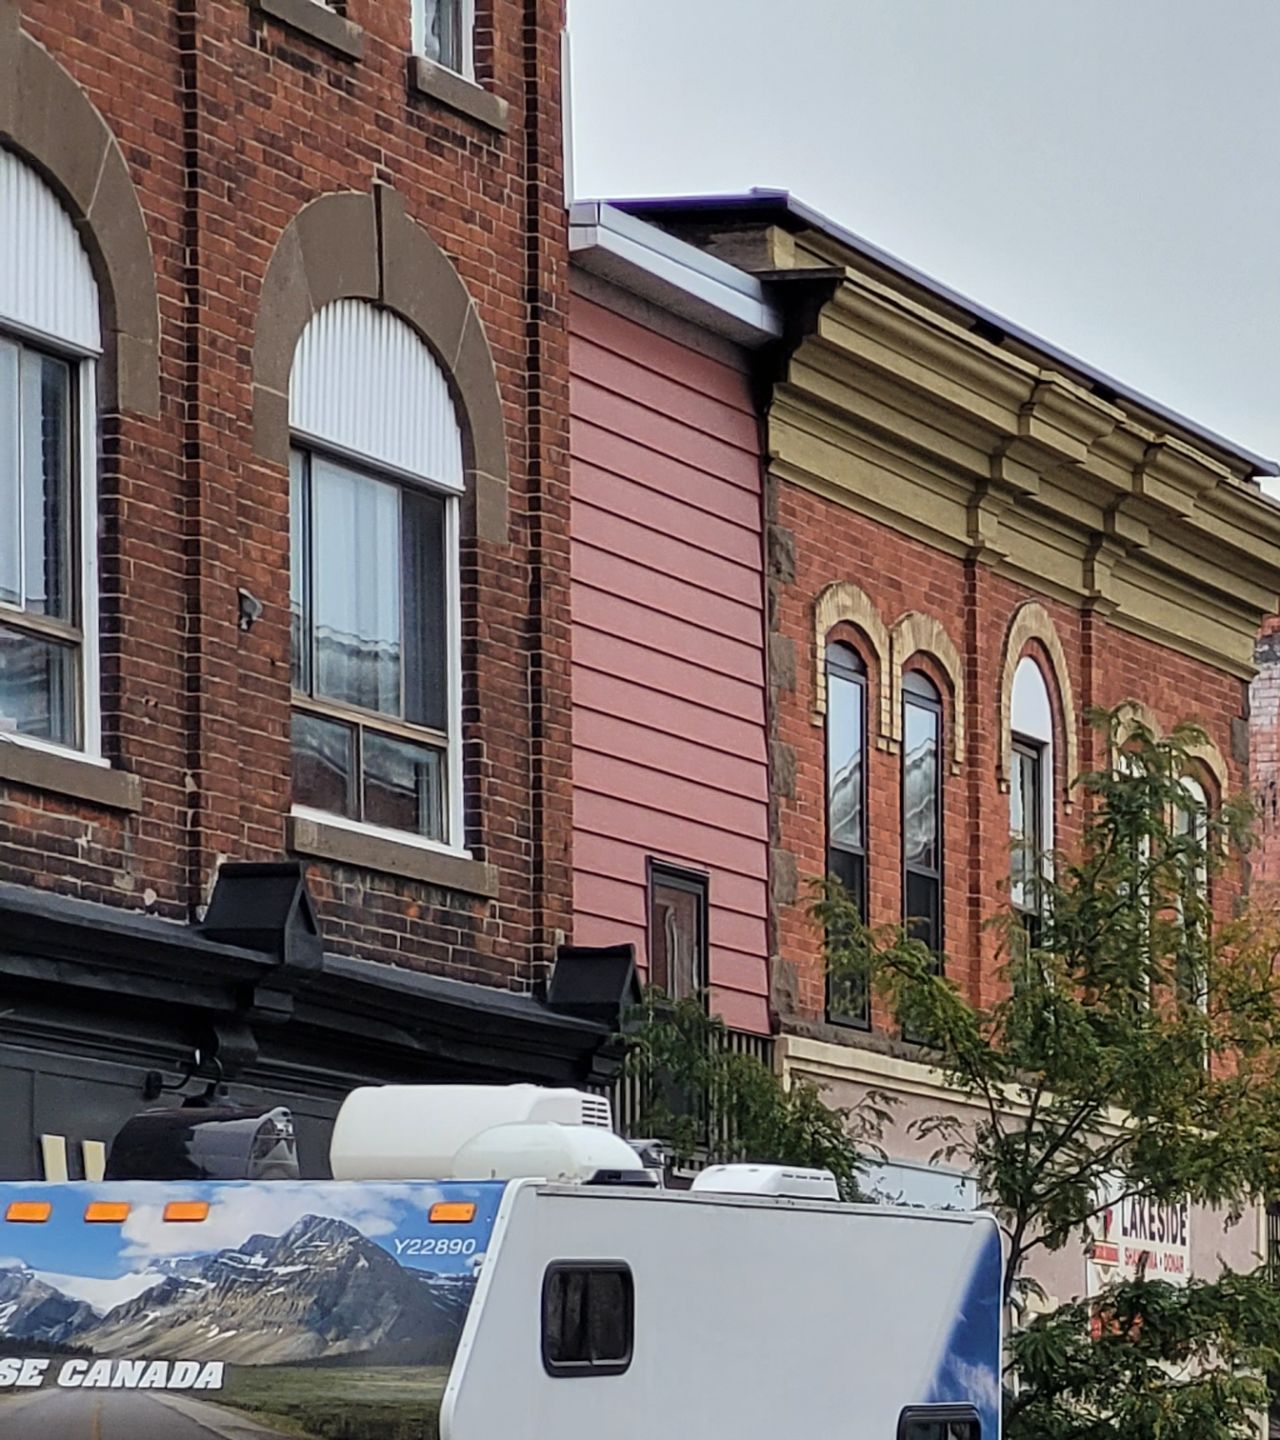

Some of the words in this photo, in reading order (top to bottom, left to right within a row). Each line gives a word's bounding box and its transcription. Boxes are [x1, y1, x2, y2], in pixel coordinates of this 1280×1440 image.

[1121, 1195, 1187, 1246] LAKESIDE
[394, 1238, 476, 1255] Y22890
[57, 1359, 224, 1389] CANADA
